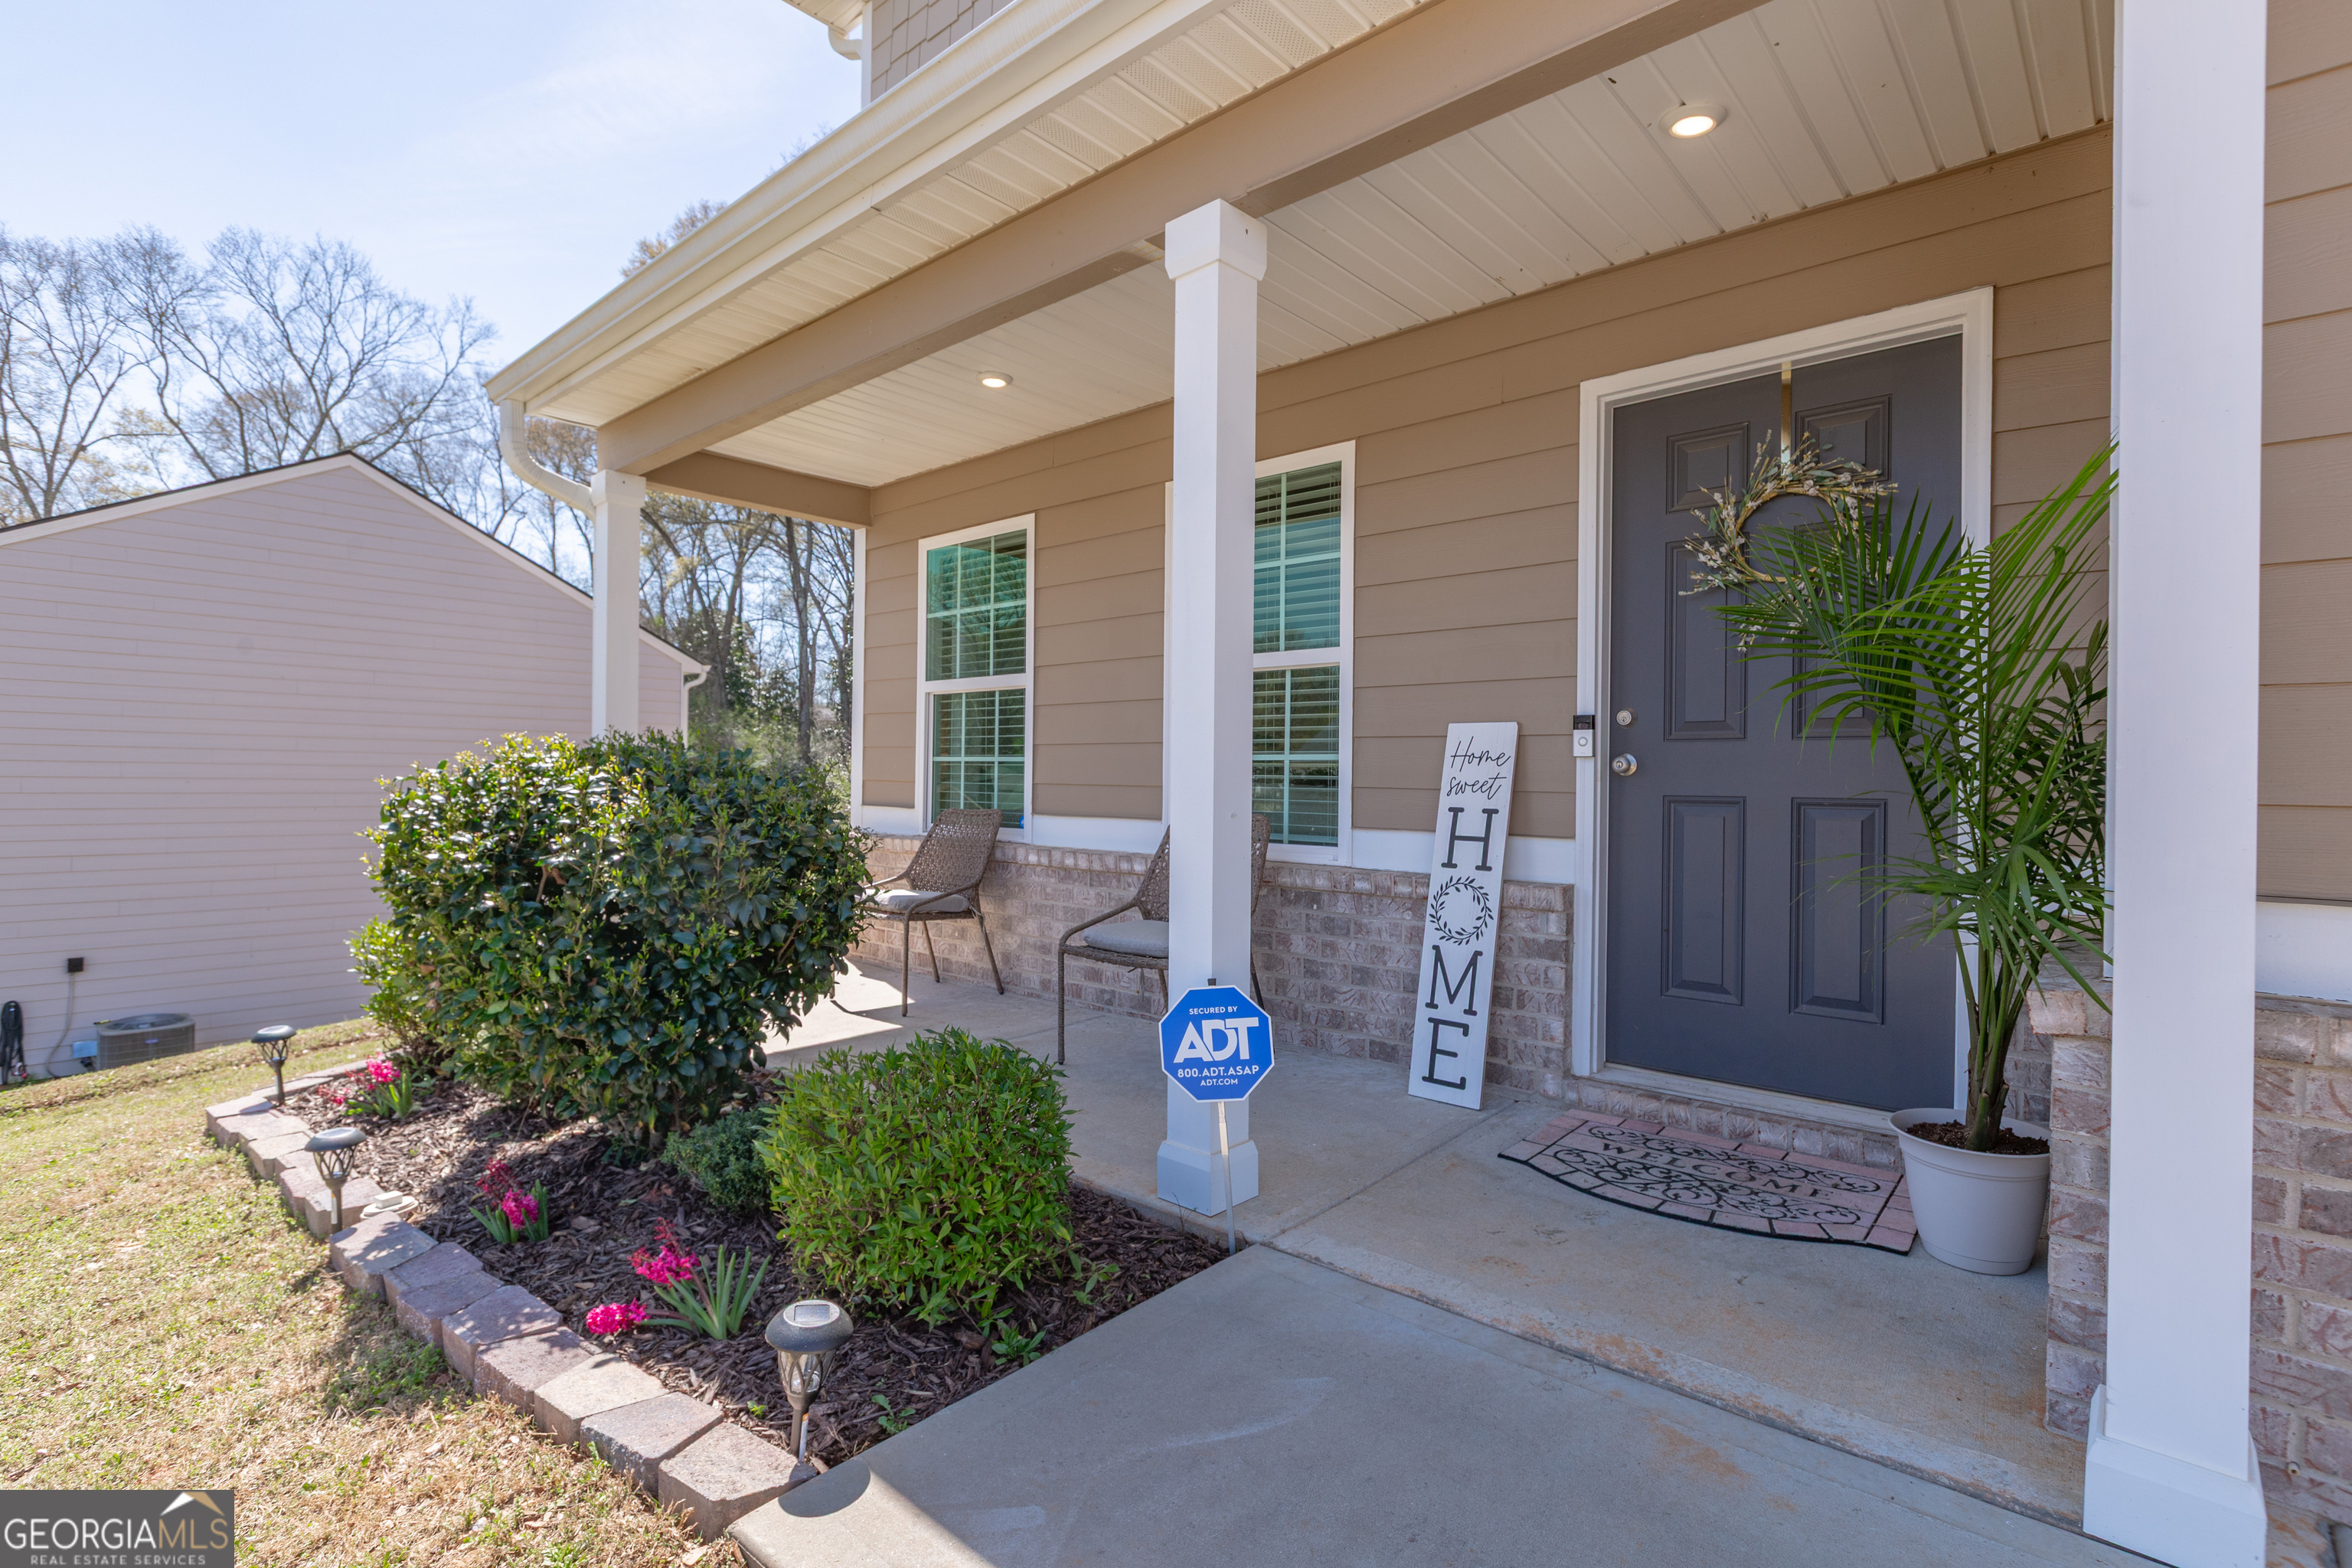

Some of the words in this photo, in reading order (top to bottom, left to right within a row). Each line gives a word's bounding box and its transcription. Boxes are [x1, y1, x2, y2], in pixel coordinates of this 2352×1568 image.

[1450, 736, 1511, 773] Home
[1446, 773, 1507, 800] sweet
[1173, 1017, 1259, 1063] ADT
[1178, 1065, 1259, 1078] 800.ADT.ASAP
[1200, 1078, 1238, 1086] ADT.COM
[1602, 1142, 1834, 1200] WELCOME
